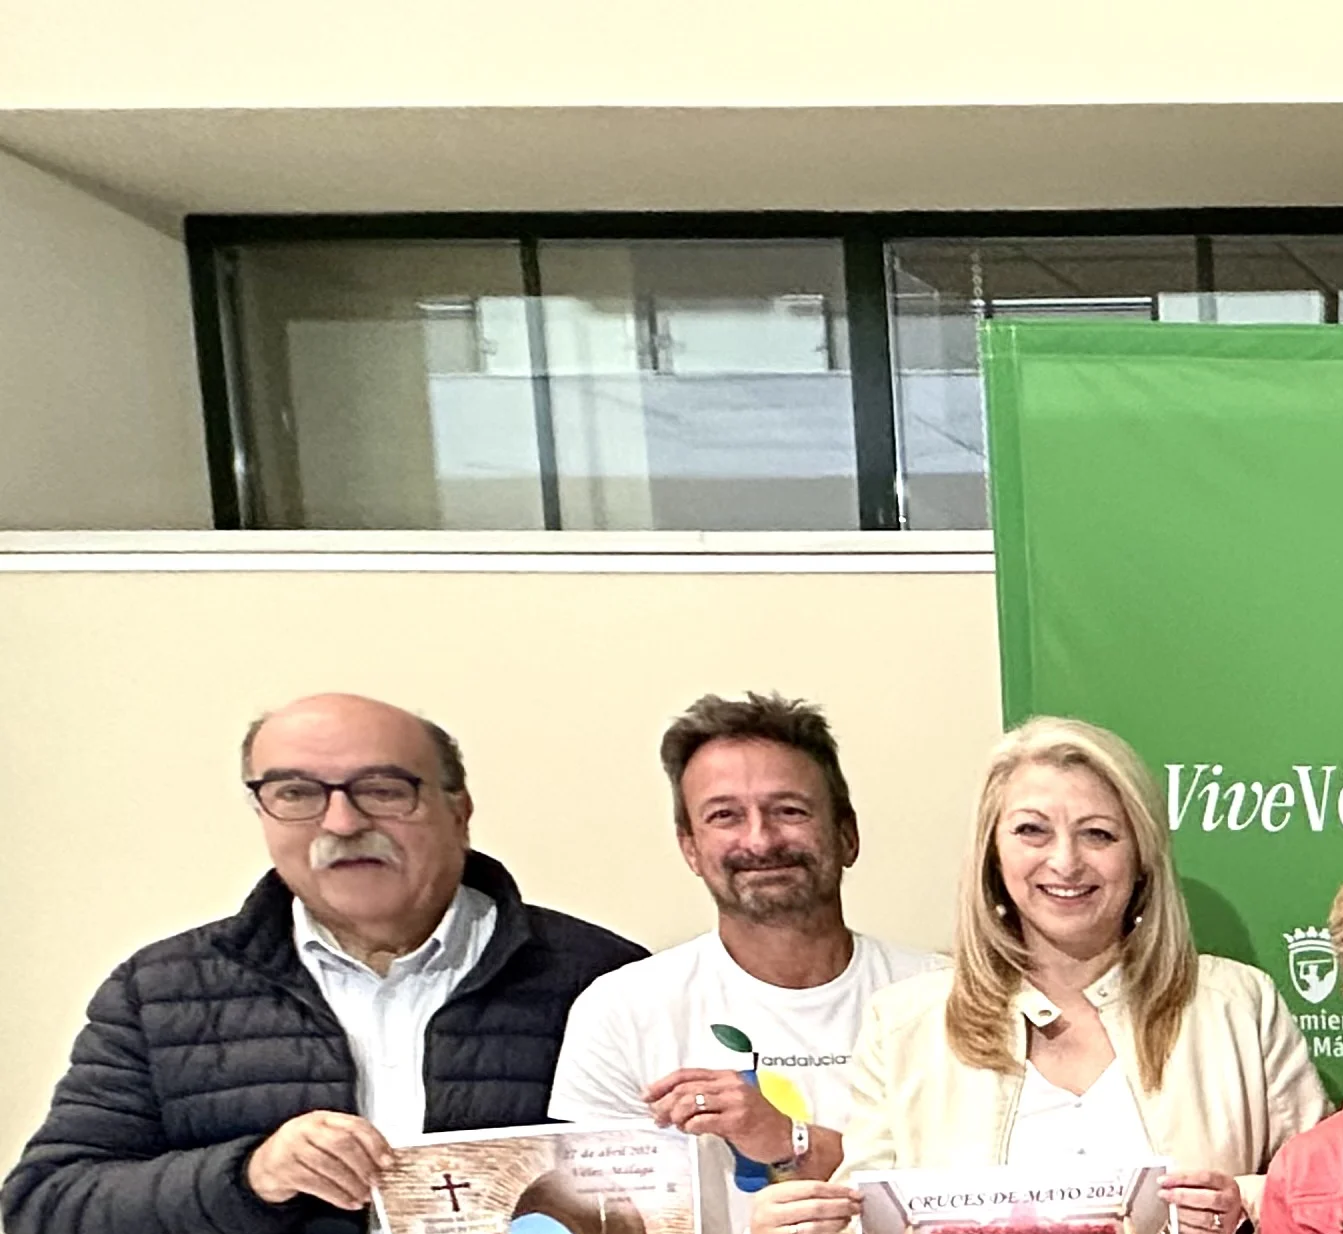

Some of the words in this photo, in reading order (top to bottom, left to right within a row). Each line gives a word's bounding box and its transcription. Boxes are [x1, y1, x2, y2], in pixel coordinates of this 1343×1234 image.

[907, 1191, 985, 1211] CRUCES
[991, 1191, 1019, 1205] DE
[1023, 1186, 1081, 1205] MAYO
[1086, 1184, 1125, 1199] 2024
